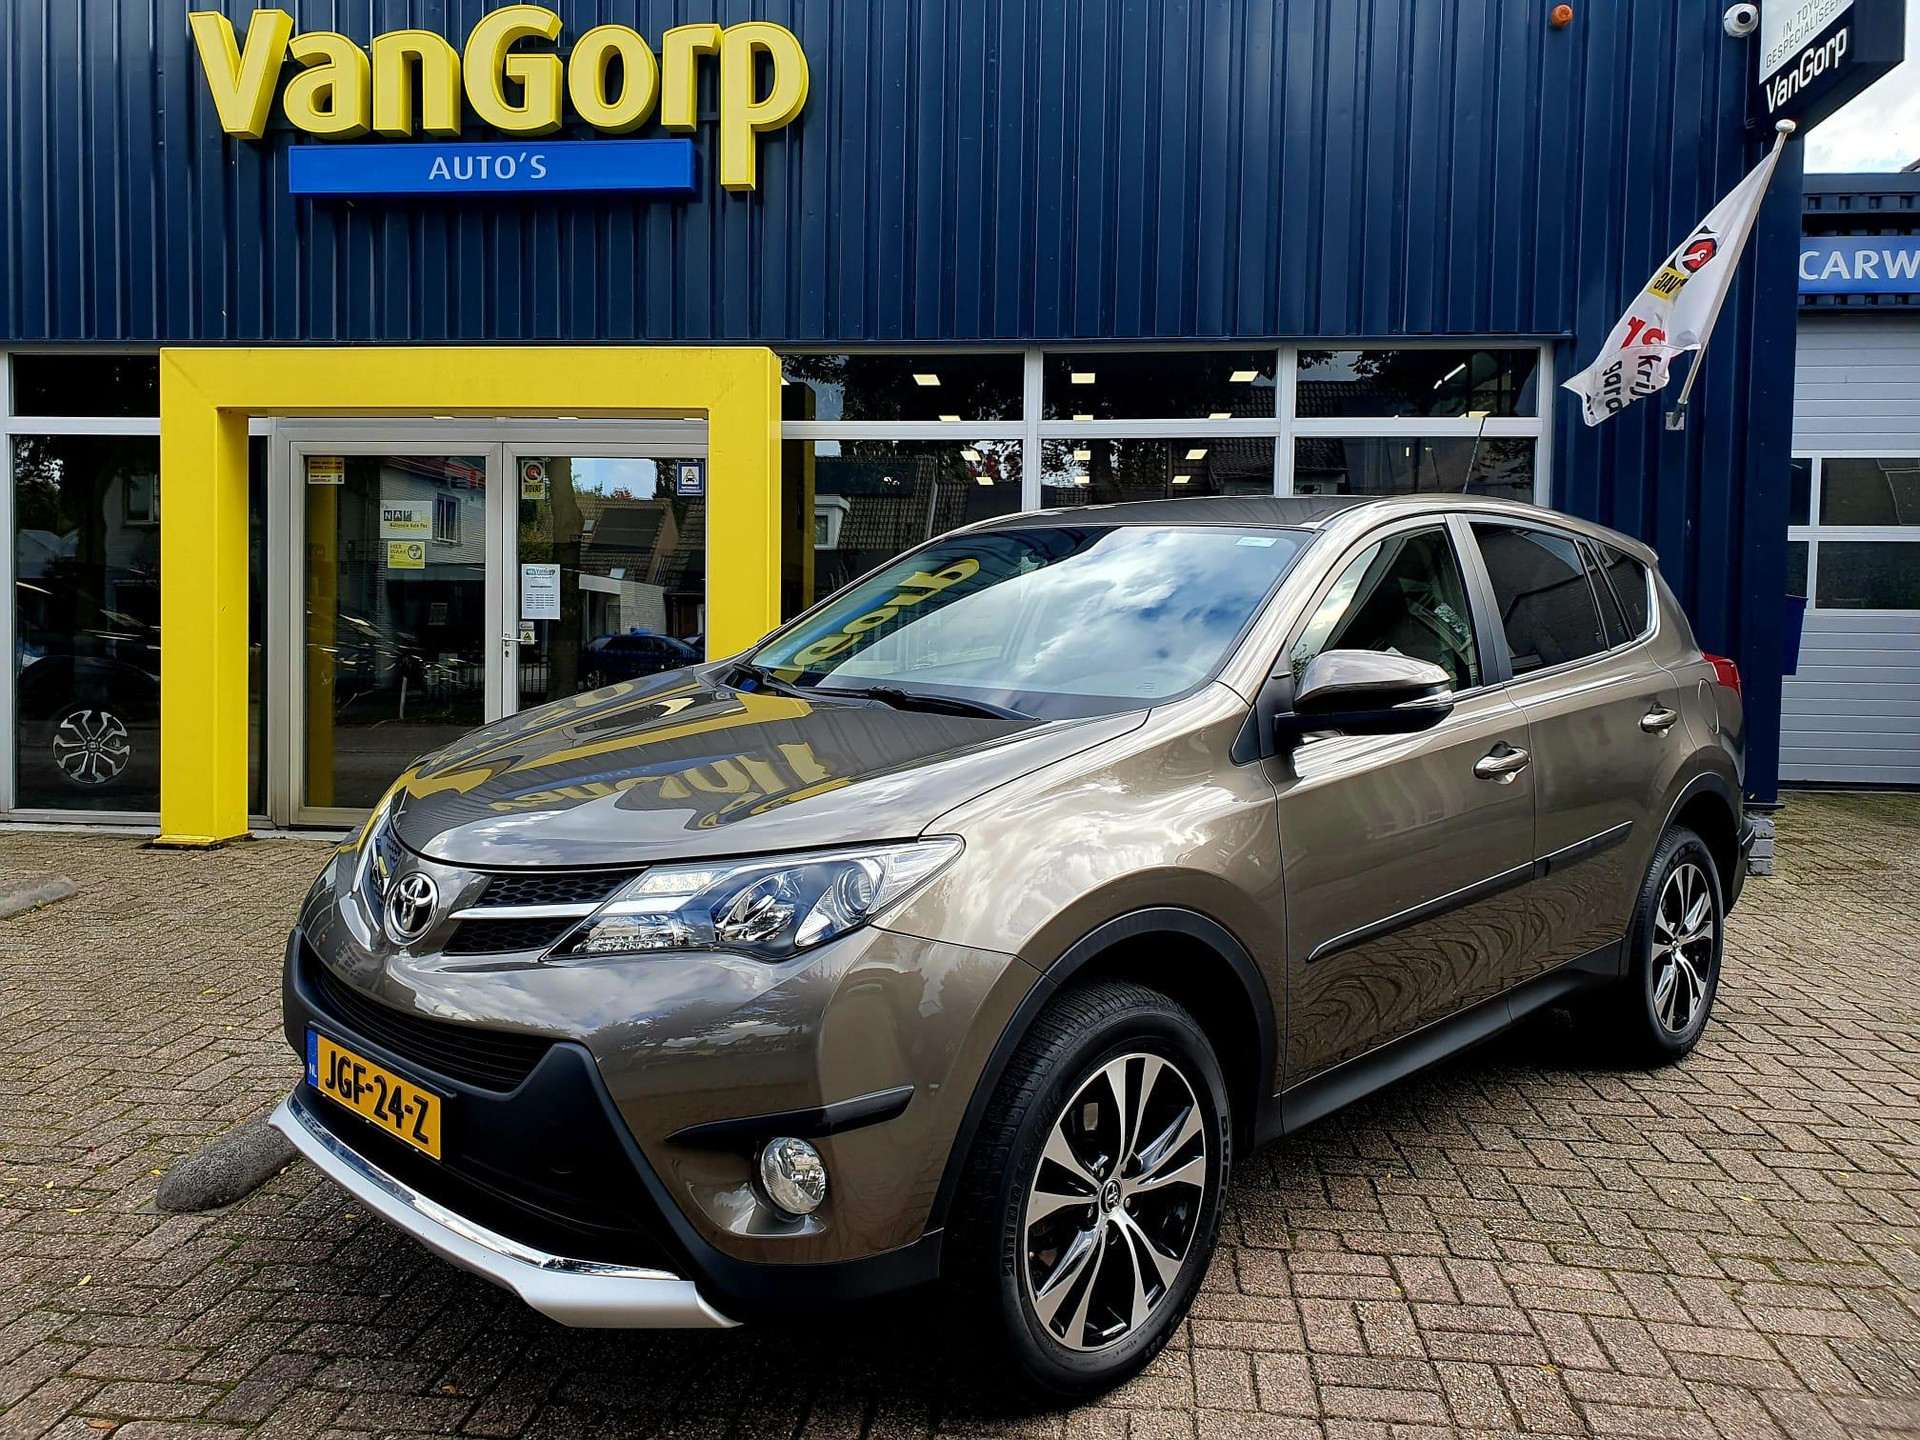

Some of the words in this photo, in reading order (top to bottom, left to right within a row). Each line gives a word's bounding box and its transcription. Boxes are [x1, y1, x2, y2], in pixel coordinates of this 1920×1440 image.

[1783, 18, 1793, 38] IN
[1796, 0, 1823, 26] TOYO
[1766, 27, 1847, 114] VanGorp
[189, 5, 810, 192] VanGorp
[429, 152, 547, 182] AUTO'S
[1799, 250, 1920, 280] CARW
[308, 1062, 318, 1078] NL
[325, 1050, 429, 1145] JGF-24-Z
